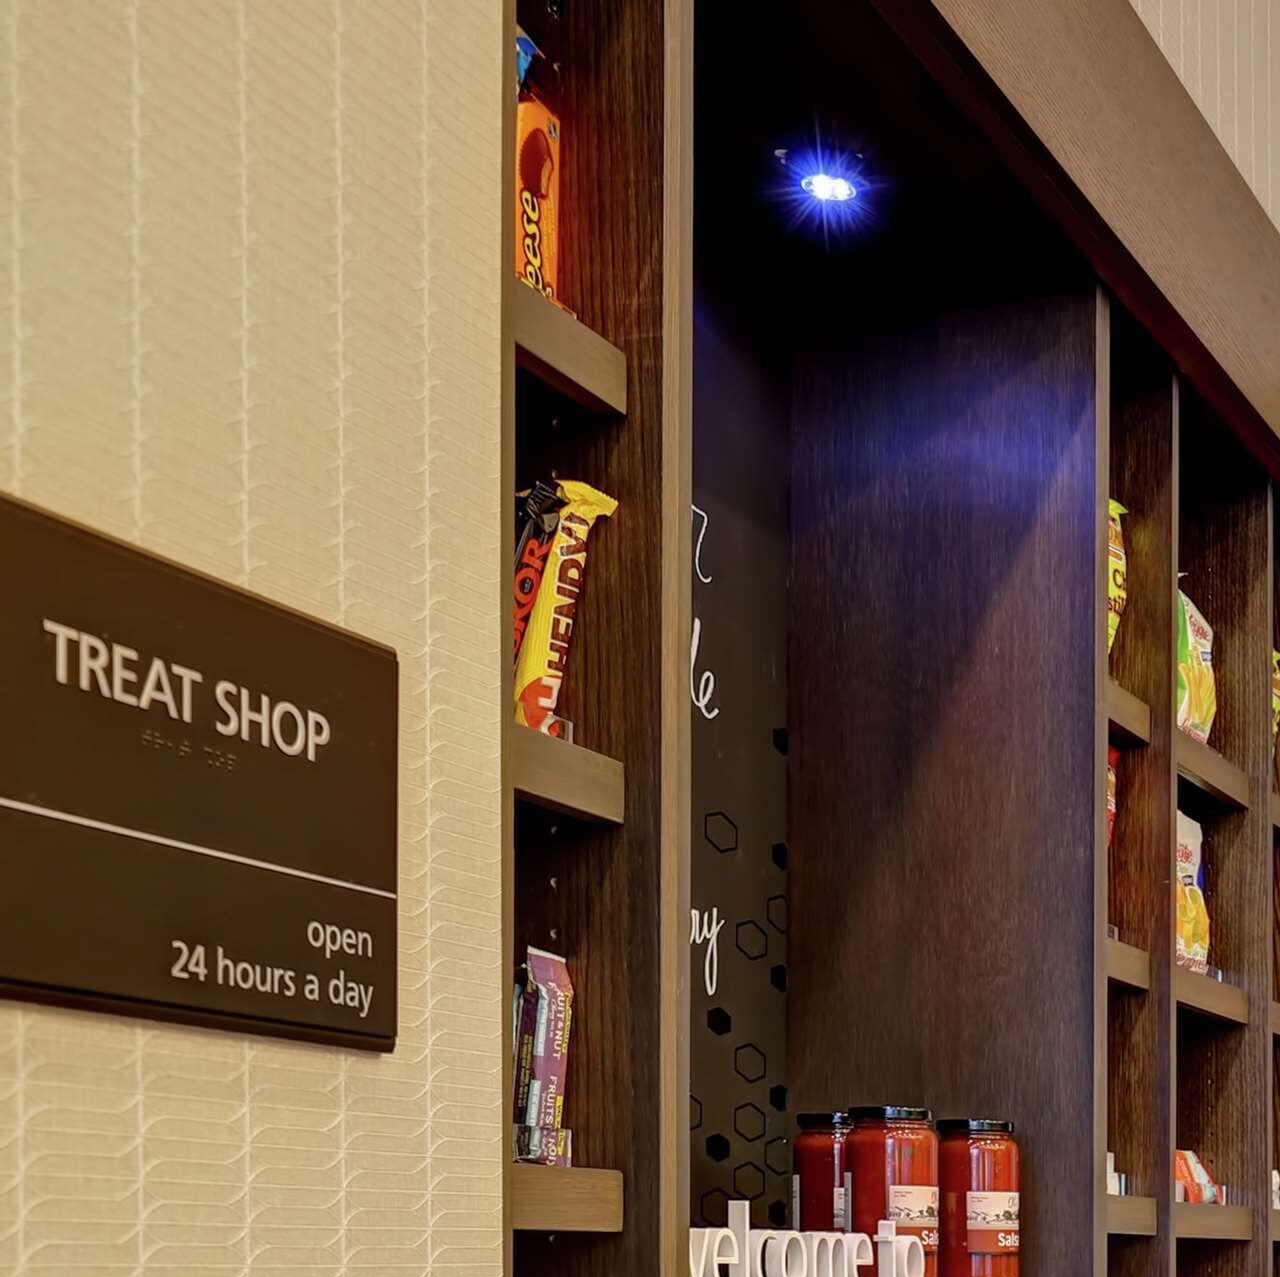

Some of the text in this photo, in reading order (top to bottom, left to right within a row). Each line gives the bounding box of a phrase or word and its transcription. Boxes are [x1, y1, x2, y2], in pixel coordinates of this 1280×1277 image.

[521, 189, 548, 293] eese
[43, 618, 203, 724] TREAT
[215, 679, 332, 763] SHOP
[170, 940, 374, 1018] 24 hours a day
[307, 919, 373, 959] open
